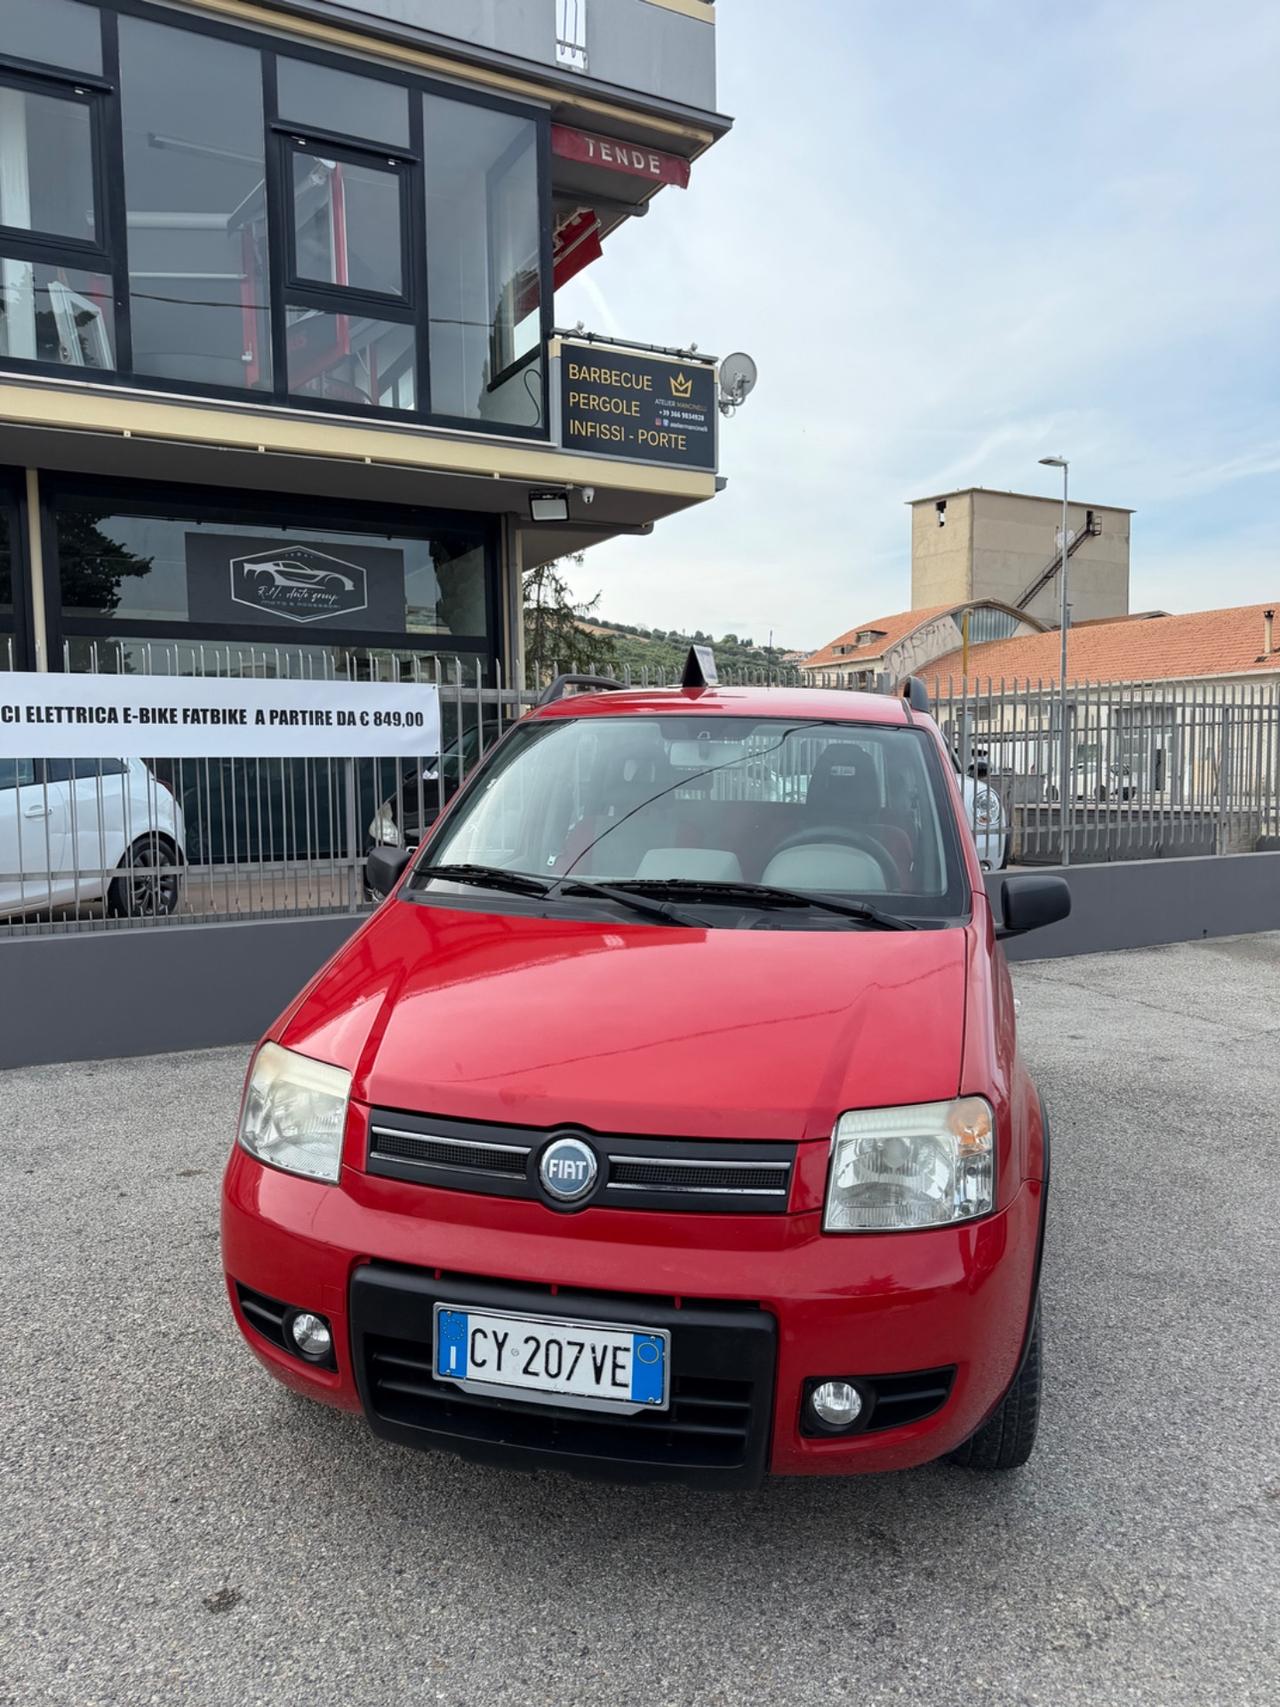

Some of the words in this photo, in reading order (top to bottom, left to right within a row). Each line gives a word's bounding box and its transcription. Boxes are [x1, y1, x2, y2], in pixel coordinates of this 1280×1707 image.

[585, 137, 661, 174] TENDE
[568, 363, 653, 391] BARBECUE
[569, 392, 640, 417] PERGOLE
[569, 419, 625, 441] INFISSI
[637, 429, 688, 450] PORTE
[26, 706, 119, 724] ELETTRICA
[123, 707, 178, 725] E-BIKE
[182, 708, 247, 725] FATBIKE
[255, 709, 265, 726] A
[269, 709, 333, 726] PARTIRE
[337, 710, 356, 727] DA
[373, 711, 424, 728] 849,00
[548, 1159, 587, 1180] FIAT
[470, 1328, 509, 1372] CY
[522, 1335, 631, 1388] 207VE
